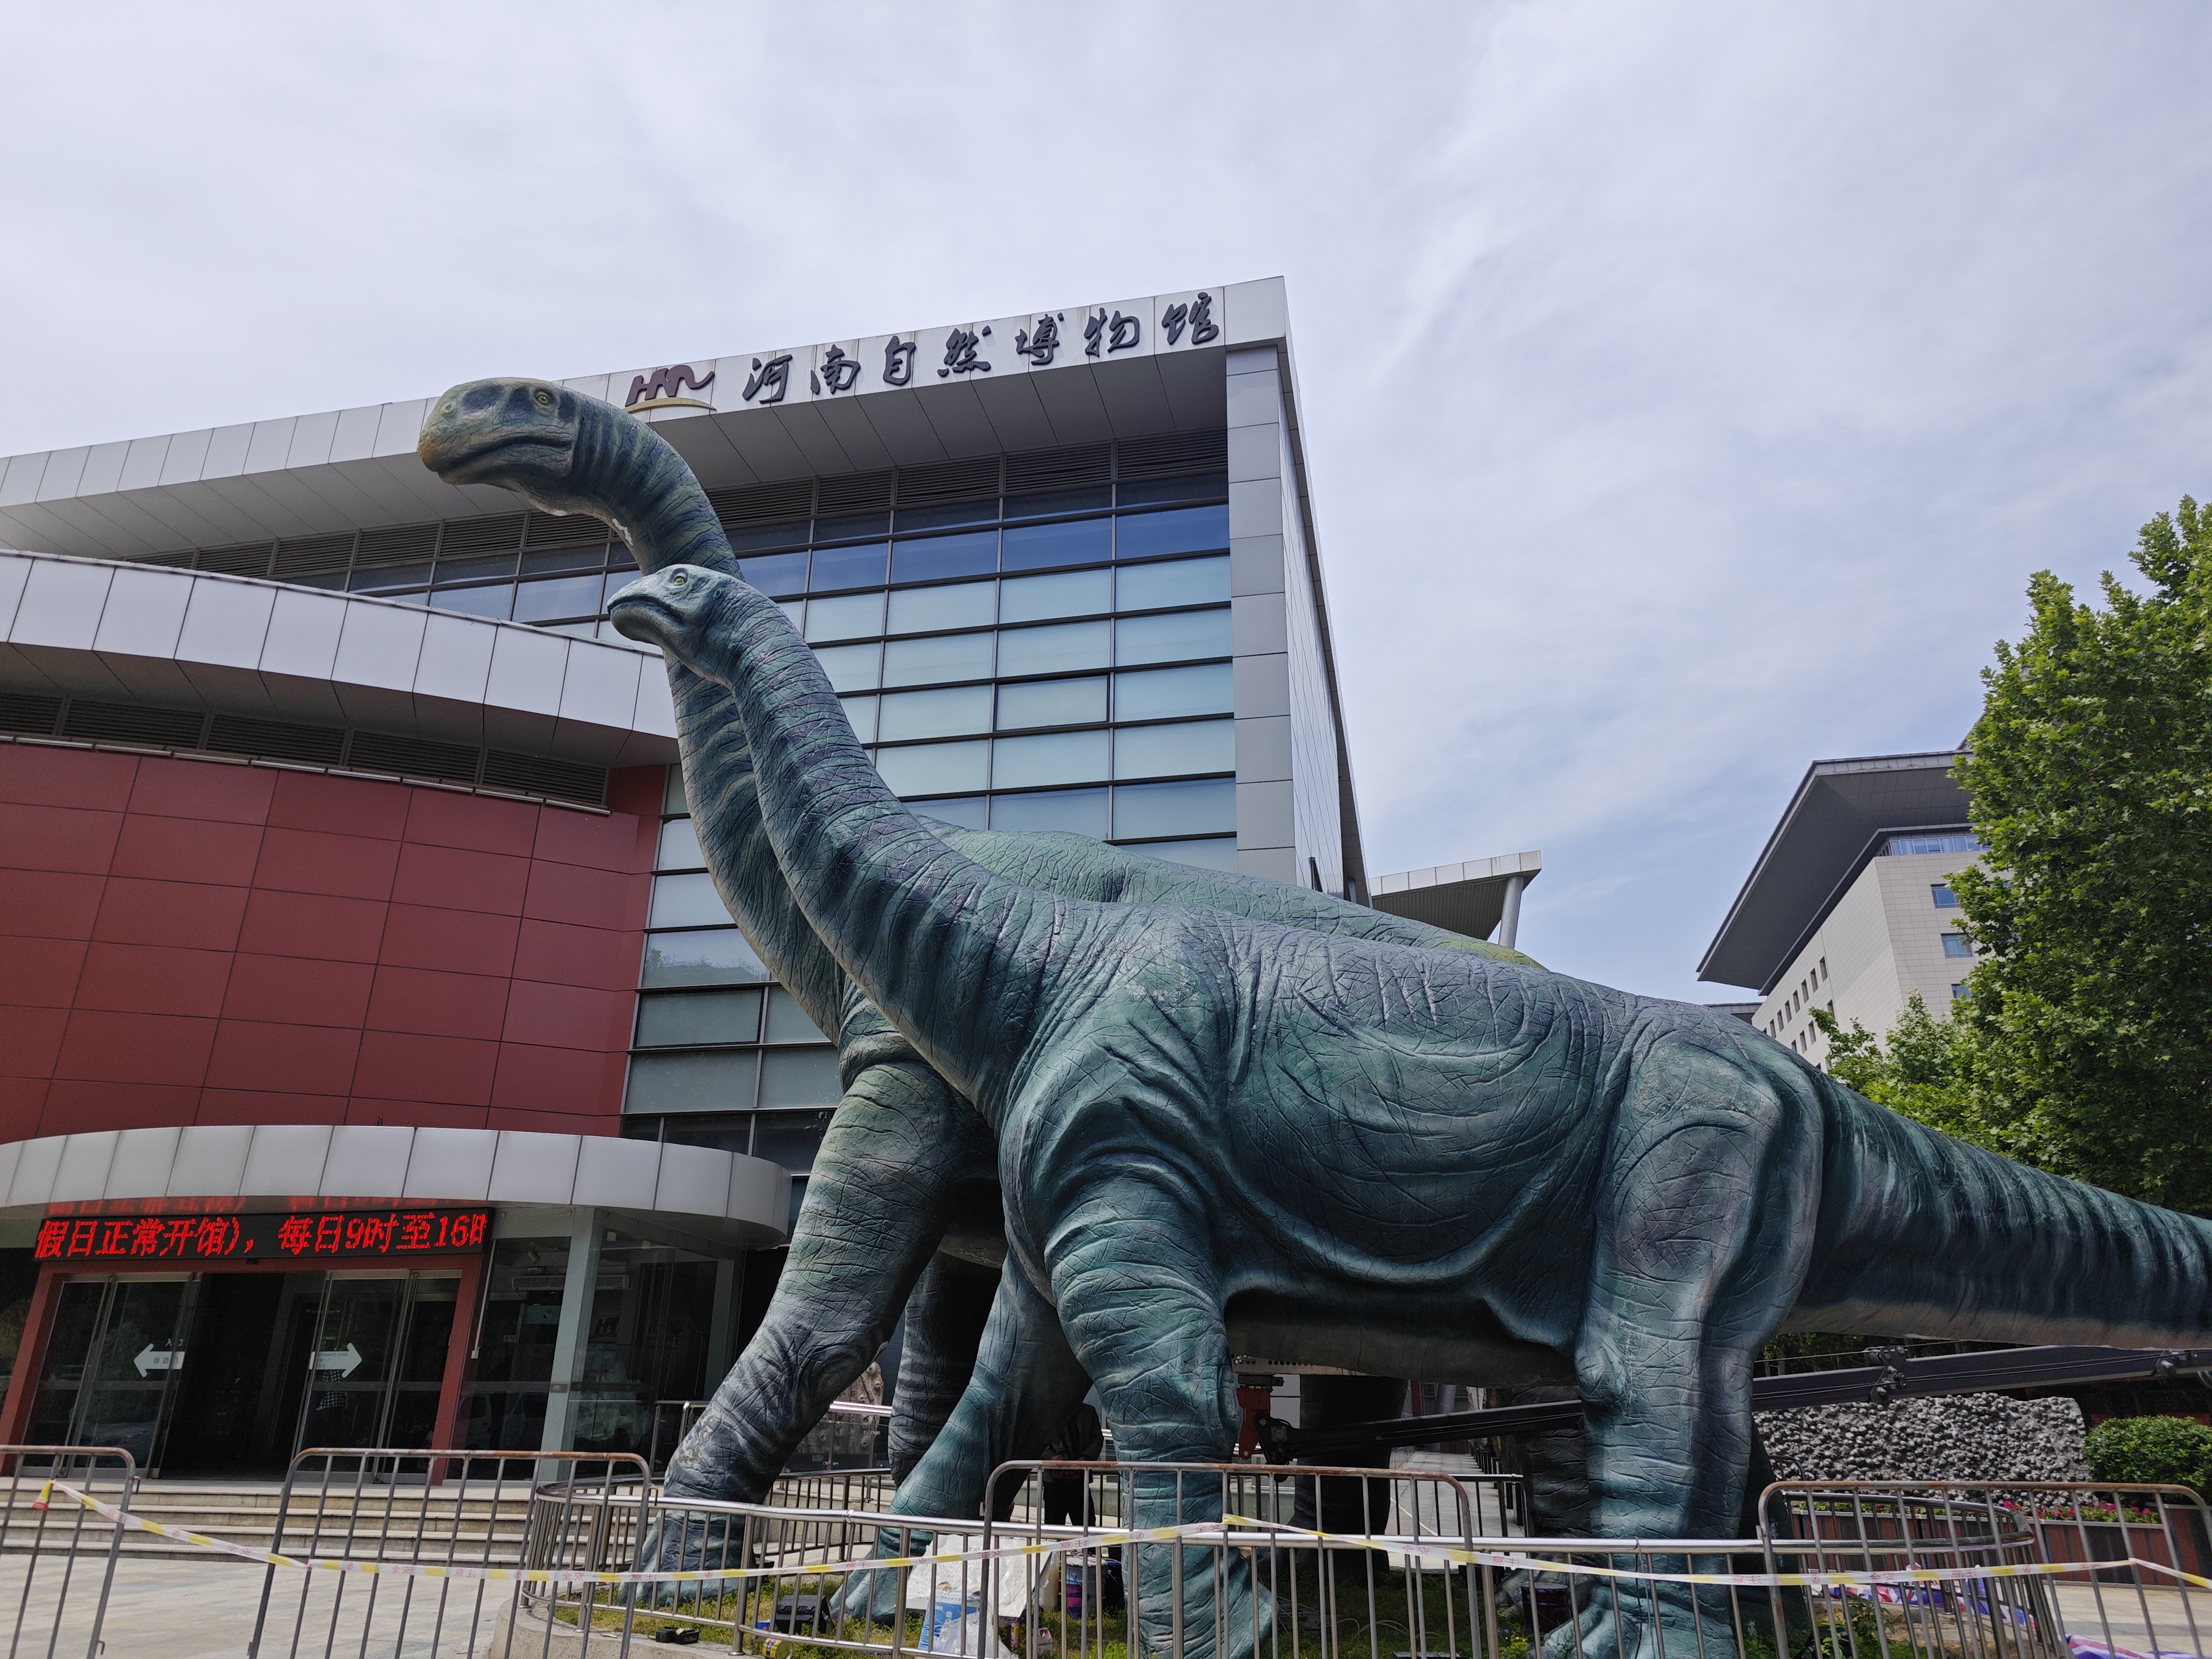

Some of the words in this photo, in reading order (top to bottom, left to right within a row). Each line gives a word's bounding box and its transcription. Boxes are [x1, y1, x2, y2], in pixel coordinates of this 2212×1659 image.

[742, 292, 1219, 403] 河南自然博物馆
